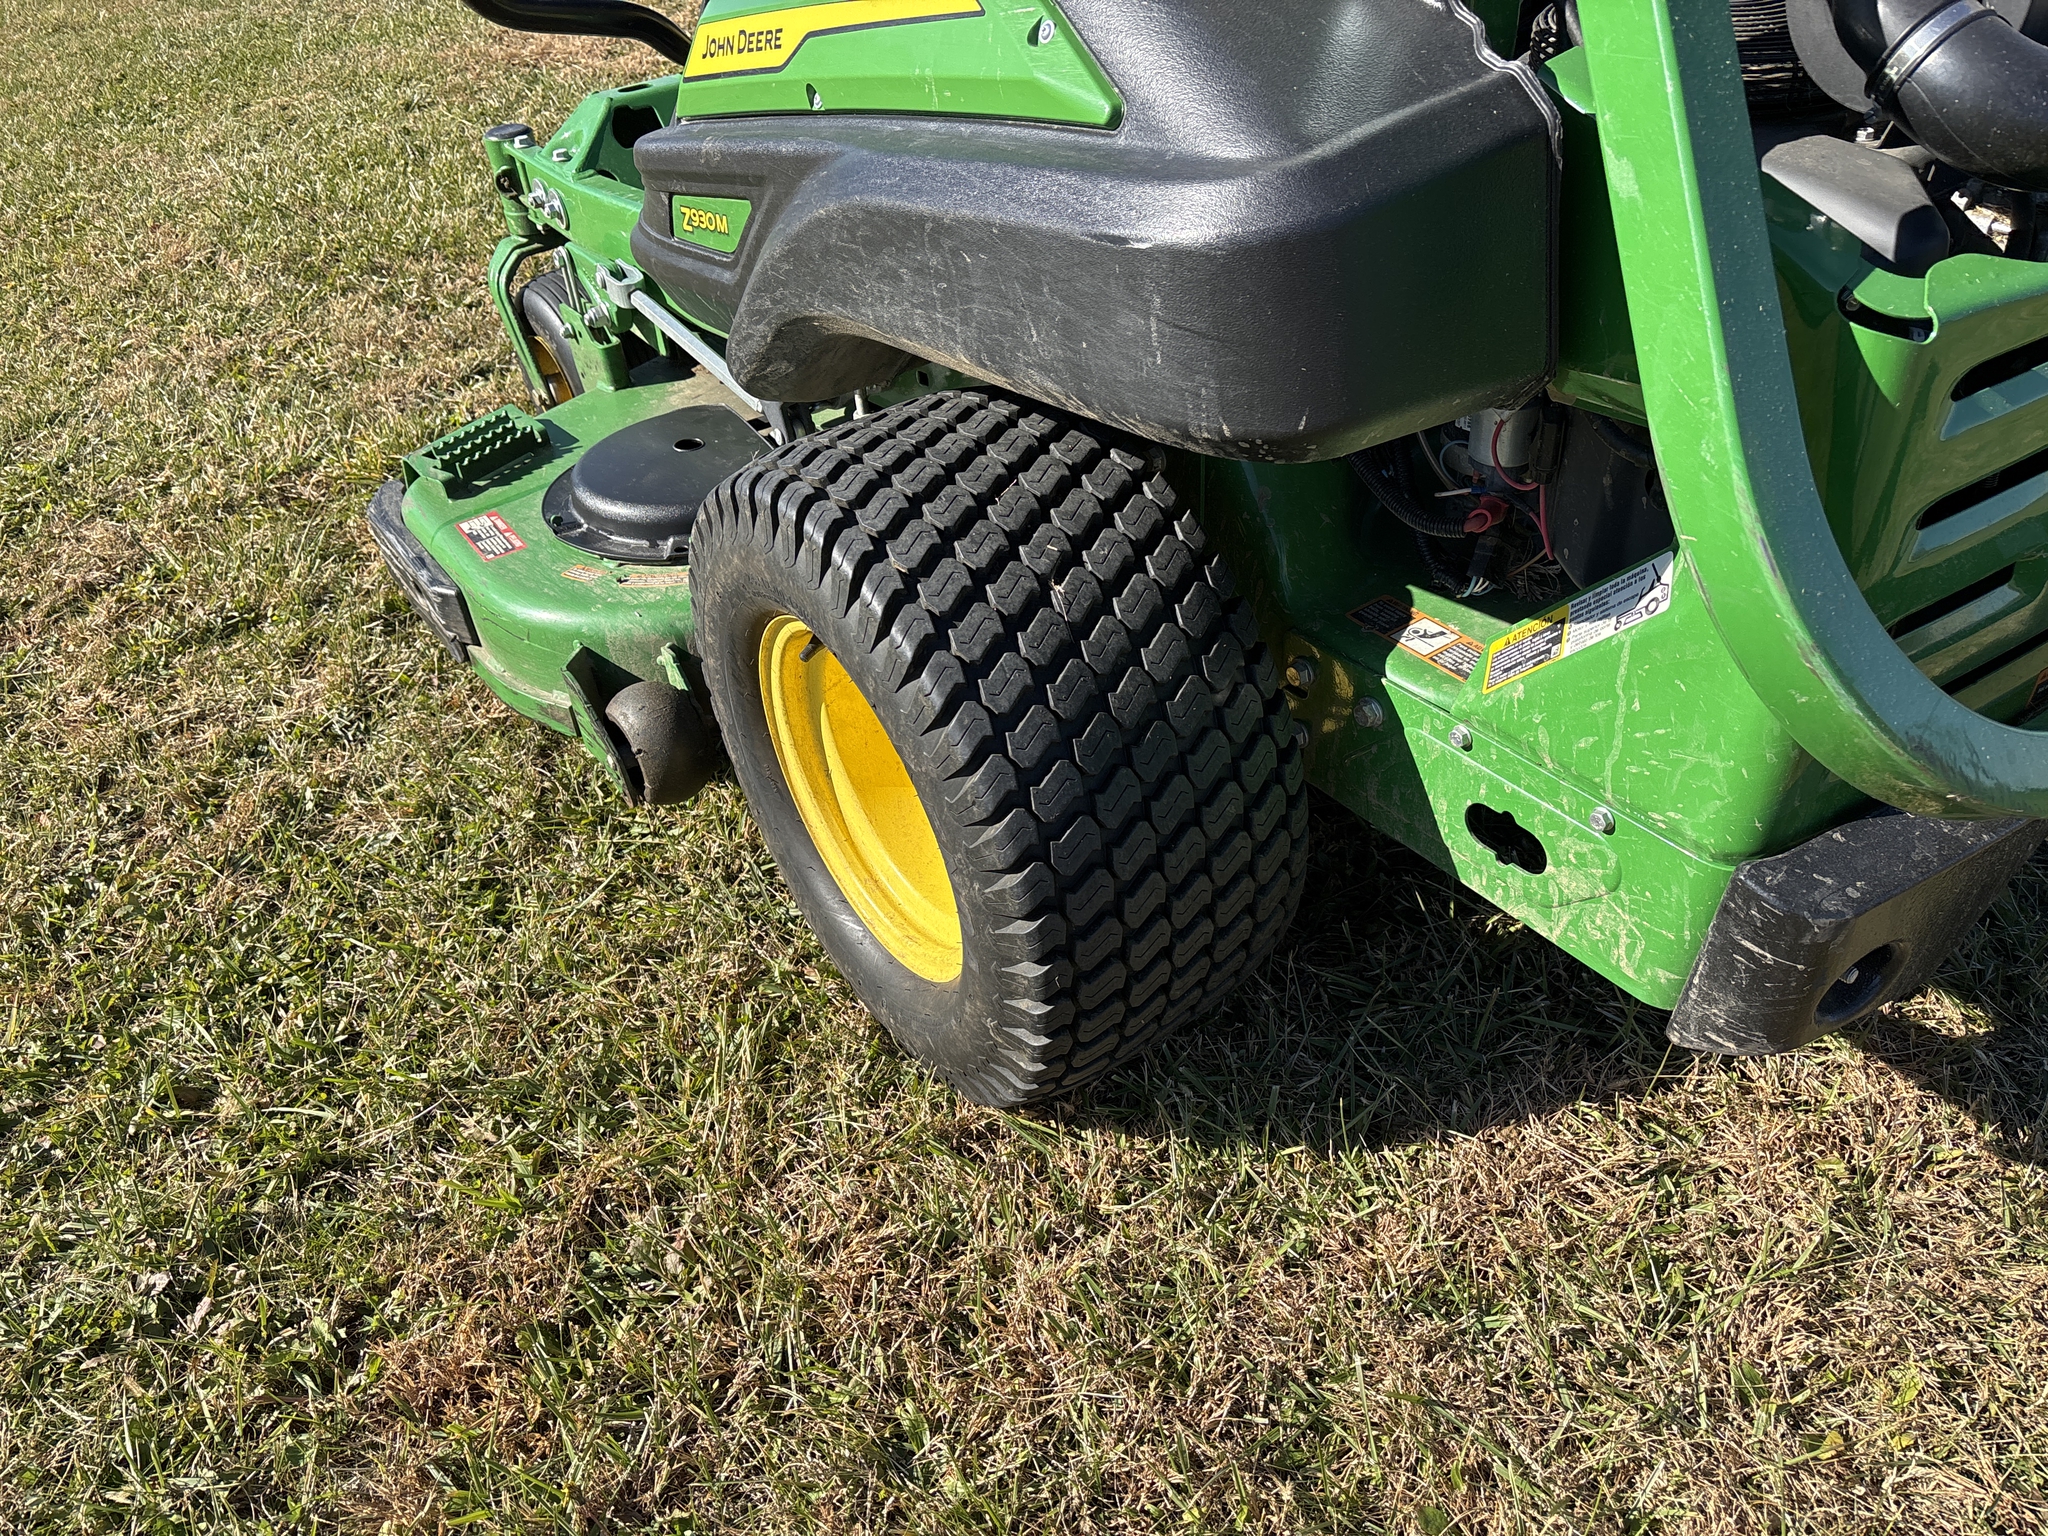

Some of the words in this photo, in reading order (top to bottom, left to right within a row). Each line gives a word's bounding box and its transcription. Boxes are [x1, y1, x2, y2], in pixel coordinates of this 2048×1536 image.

[702, 35, 735, 59] JOHN
[737, 28, 783, 54] DEERE
[680, 205, 729, 234] Z930M
[1610, 582, 1619, 590] toda
[1511, 614, 1554, 643] ATENCIÓN
